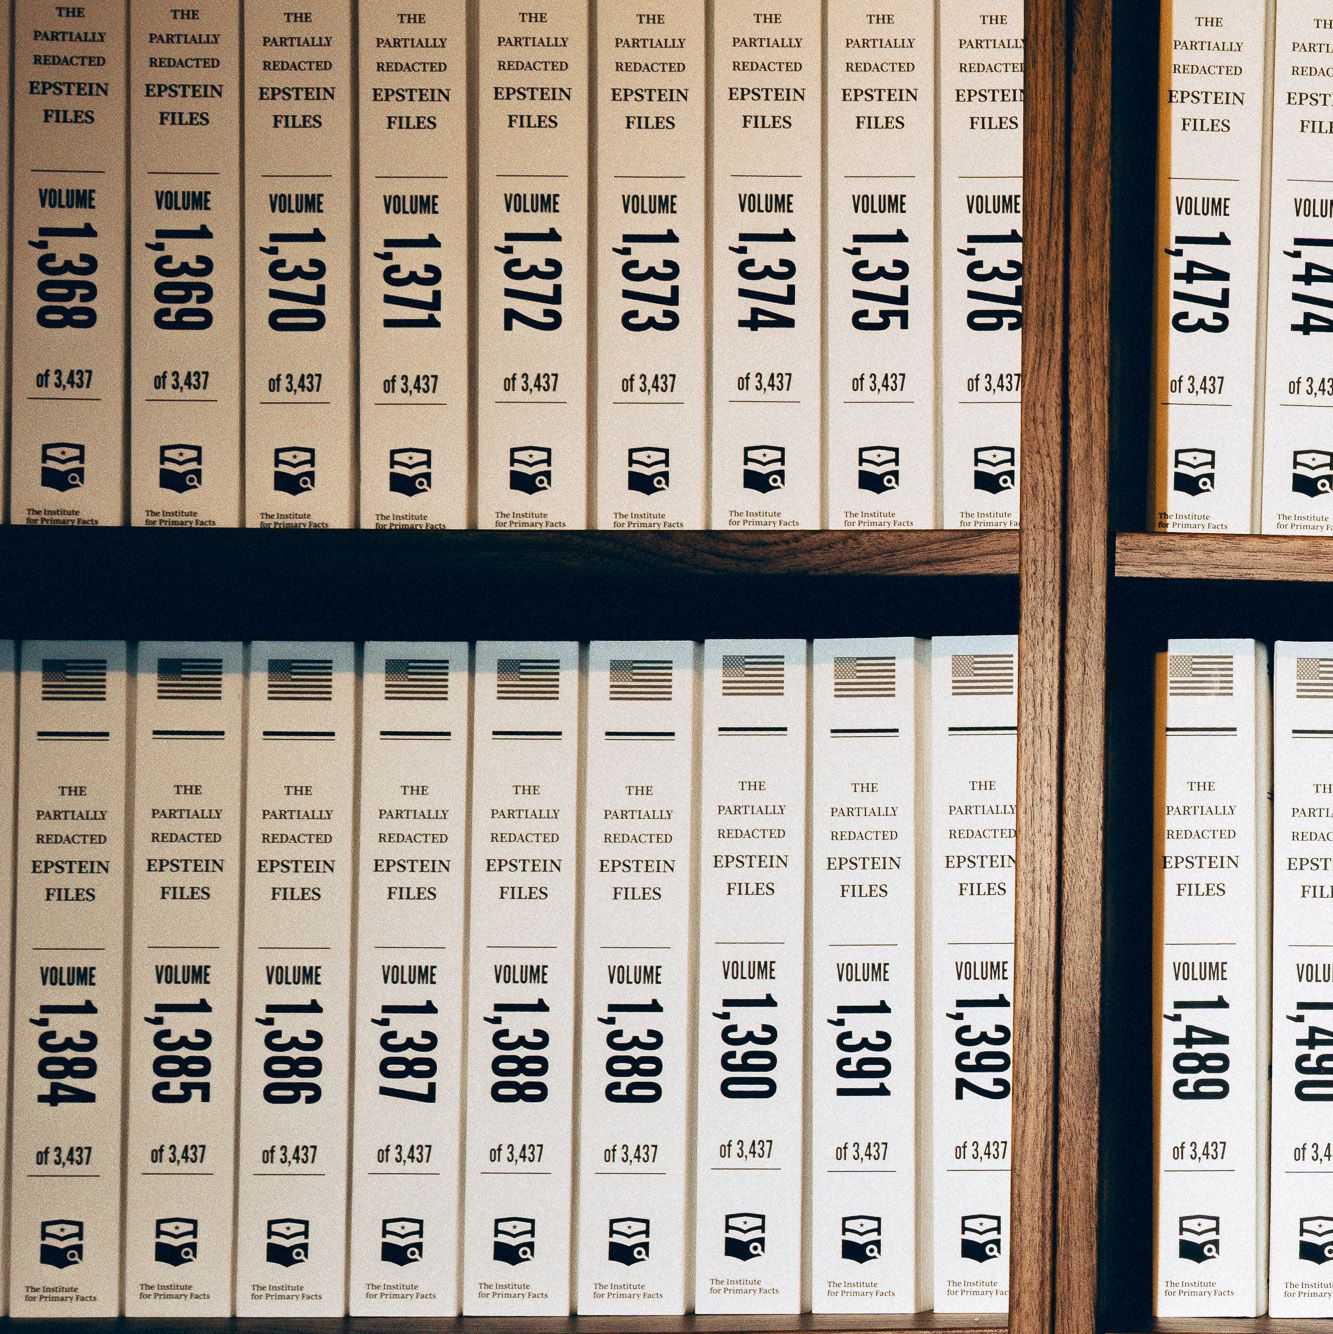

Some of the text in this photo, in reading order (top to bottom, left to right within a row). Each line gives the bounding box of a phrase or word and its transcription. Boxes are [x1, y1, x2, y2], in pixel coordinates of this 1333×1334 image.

[27, 222, 99, 329] 1,368
[259, 227, 327, 332] 1,370
[494, 227, 563, 332] 1,372
[728, 227, 797, 332] 1,374
[1164, 231, 1232, 334] 1,473
[378, 808, 447, 820] PARTIALLY
[378, 832, 449, 844] REDACTED
[400, 784, 429, 796] THE
[373, 858, 450, 873] EPSTEIN
[387, 886, 437, 901] FILES
[381, 964, 437, 985] VOLUME
[28, 999, 98, 1107] 1,384
[254, 998, 324, 1105] 1,386
[370, 999, 439, 1104] 1,387
[597, 998, 664, 1104] 1,389
[827, 999, 892, 1097] 1,391
[1162, 995, 1230, 1101] 1,489
[376, 1143, 433, 1165] of 3,437
[365, 1282, 419, 1291] The Institute
[365, 1291, 437, 1300] for Primary Facts
